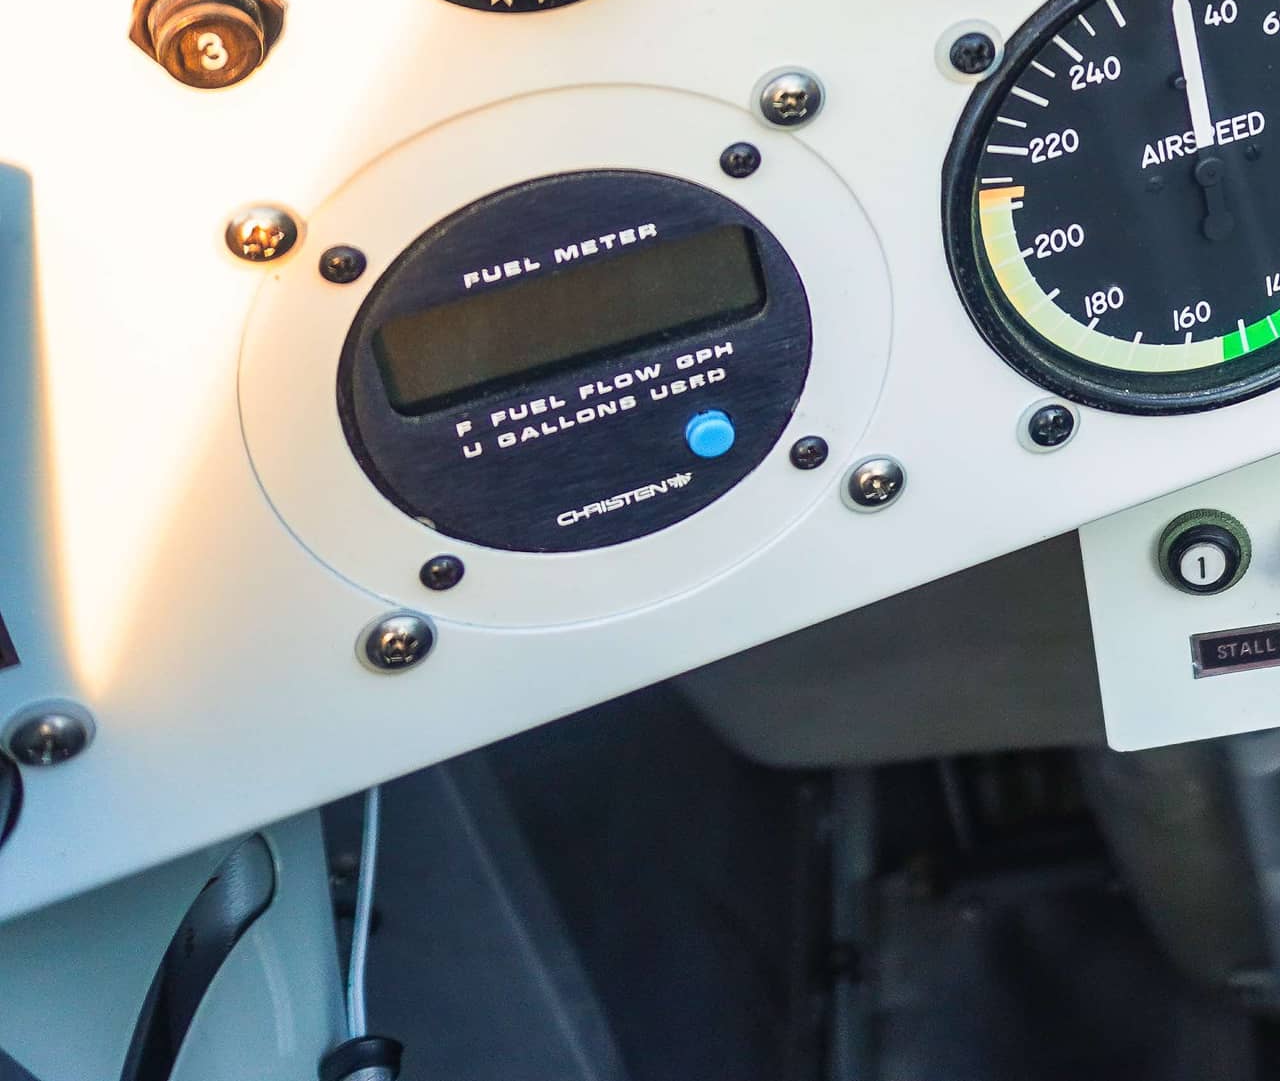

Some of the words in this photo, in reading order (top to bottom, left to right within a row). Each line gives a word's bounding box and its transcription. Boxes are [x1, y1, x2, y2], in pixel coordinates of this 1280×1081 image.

[1204, 0, 1238, 25] 40
[198, 32, 228, 70] 3
[1069, 56, 1121, 90] 240
[1028, 129, 1079, 163] 220
[464, 257, 541, 289] FUEL
[554, 223, 658, 264] METER
[1034, 224, 1084, 258] 200
[1085, 287, 1124, 317] 180
[1173, 301, 1211, 330] 160
[456, 420, 472, 437] F
[491, 395, 566, 429] FUEL
[579, 364, 662, 400] FLOW
[676, 342, 734, 371] GPH
[463, 441, 482, 458] U
[498, 396, 637, 449] GALLONS
[650, 367, 726, 401] USED
[557, 478, 668, 527] CHRISTEN
[1217, 640, 1276, 660] STALL
